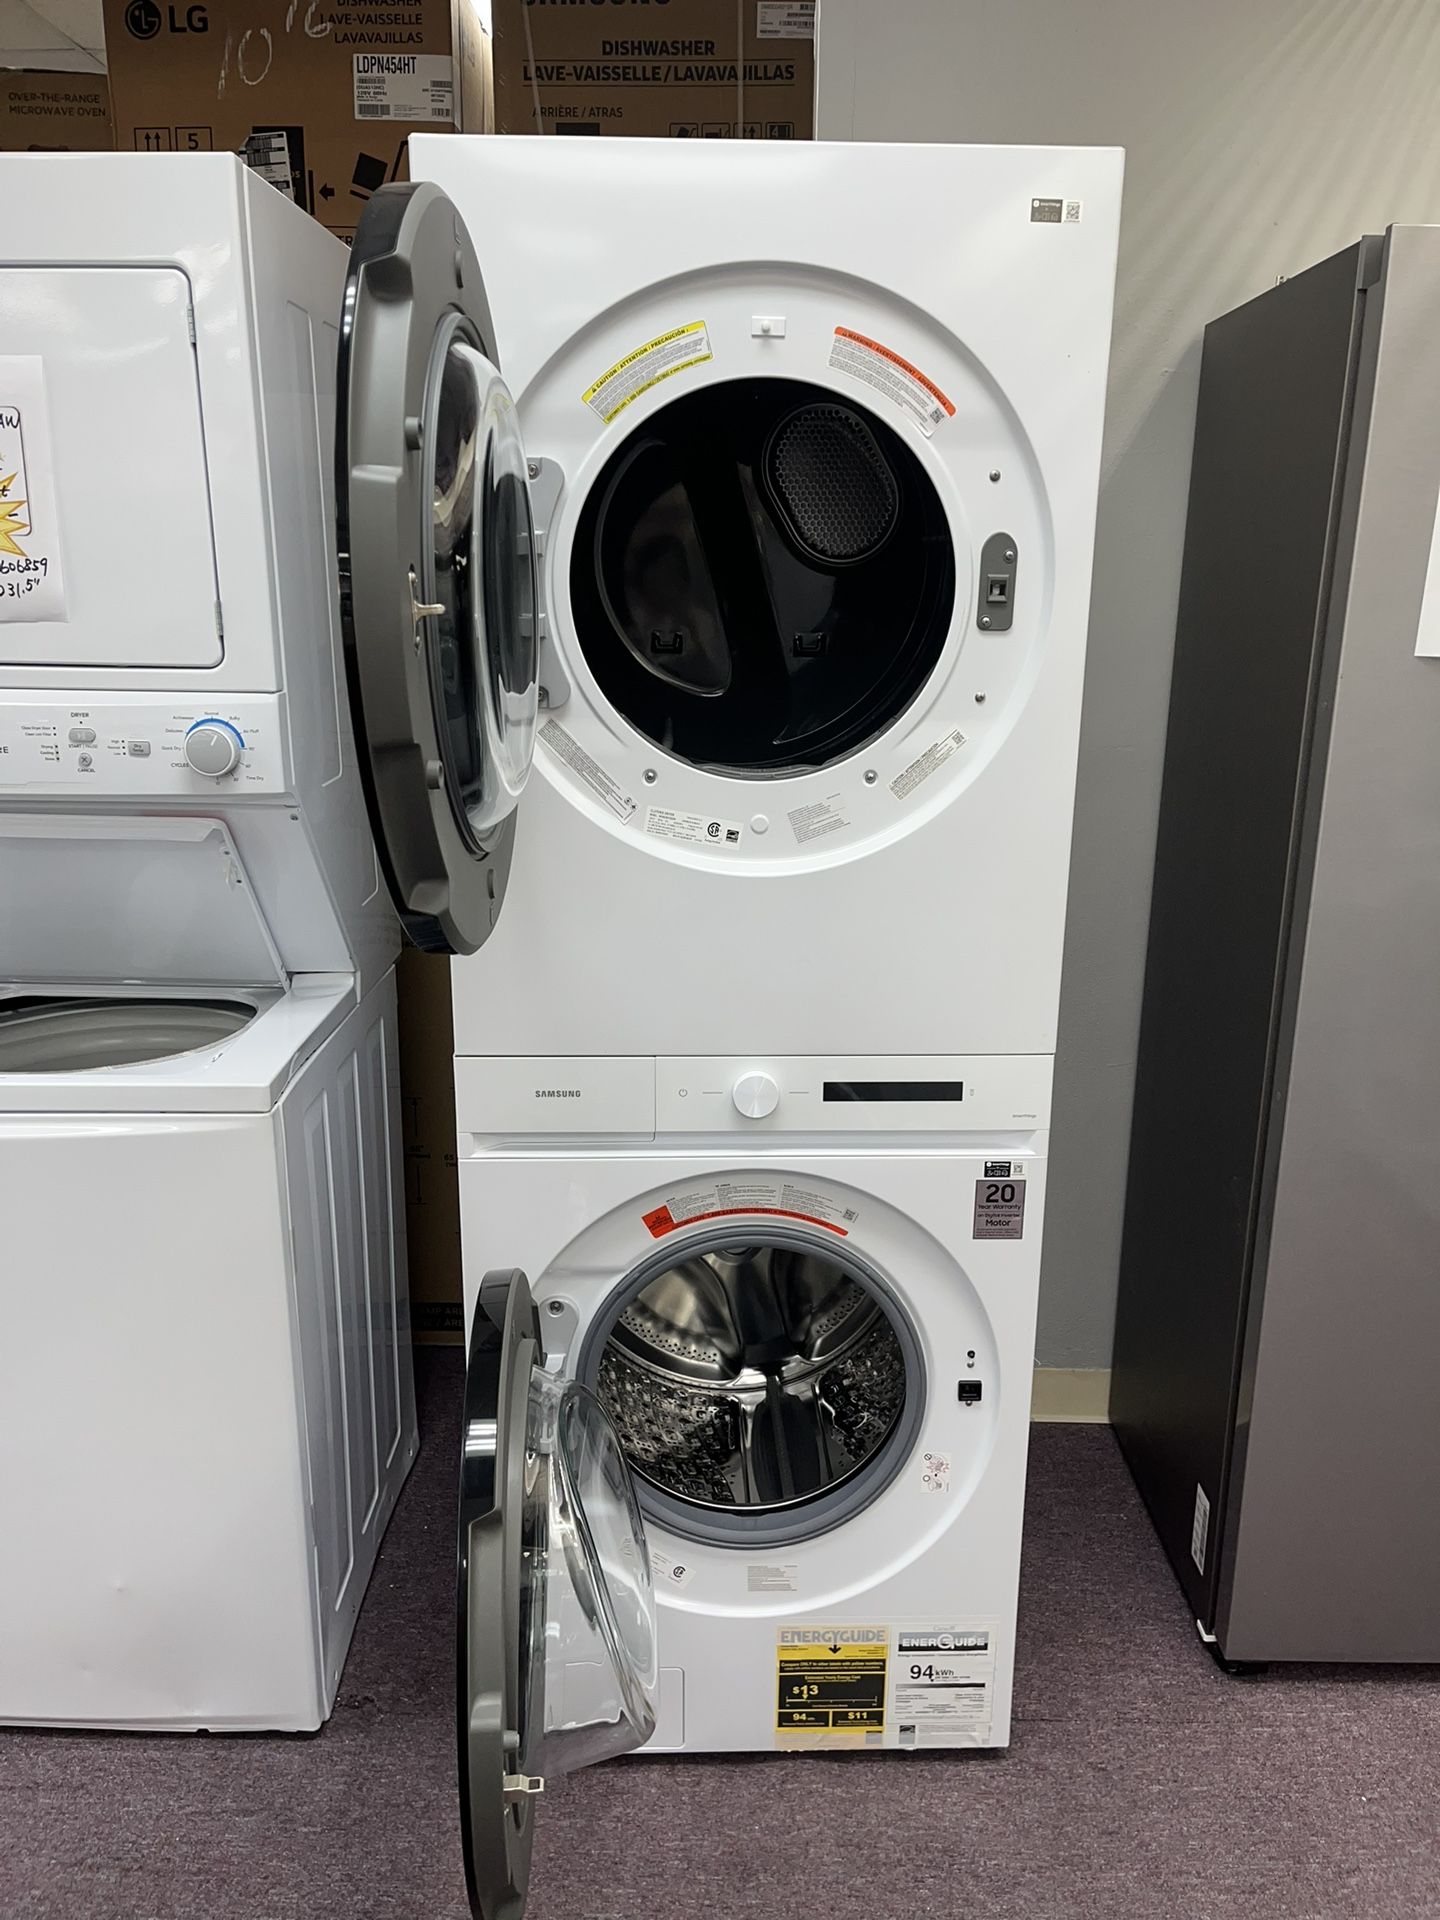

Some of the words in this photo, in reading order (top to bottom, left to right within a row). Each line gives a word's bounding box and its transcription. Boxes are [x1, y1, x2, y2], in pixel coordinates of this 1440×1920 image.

[168, 5, 209, 33] LG
[320, 13, 423, 25] LAVE-VAISSELLE
[334, 32, 424, 44] LAVAVAJILLAS
[601, 40, 716, 57] DISHWASHER
[356, 56, 417, 74] LDPN454HT
[8, 92, 100, 103] OVER-THE-RANGE
[9, 105, 75, 116] MICROWAVE
[77, 107, 106, 117] OVEN
[596, 368, 618, 389] CAUTION
[620, 347, 649, 369] ATTENTION
[651, 328, 686, 351] PRECAUCIÓN
[535, 1090, 581, 1098] SAMSUNG
[985, 1183, 1016, 1203] 20
[781, 1629, 885, 1643] ENERGYGUIDE
[902, 1633, 985, 1650] ENERGUIDE
[910, 1664, 934, 1680] 94
[792, 1685, 819, 1696] $13
[792, 1713, 807, 1721] 94
[847, 1712, 868, 1720] $11
